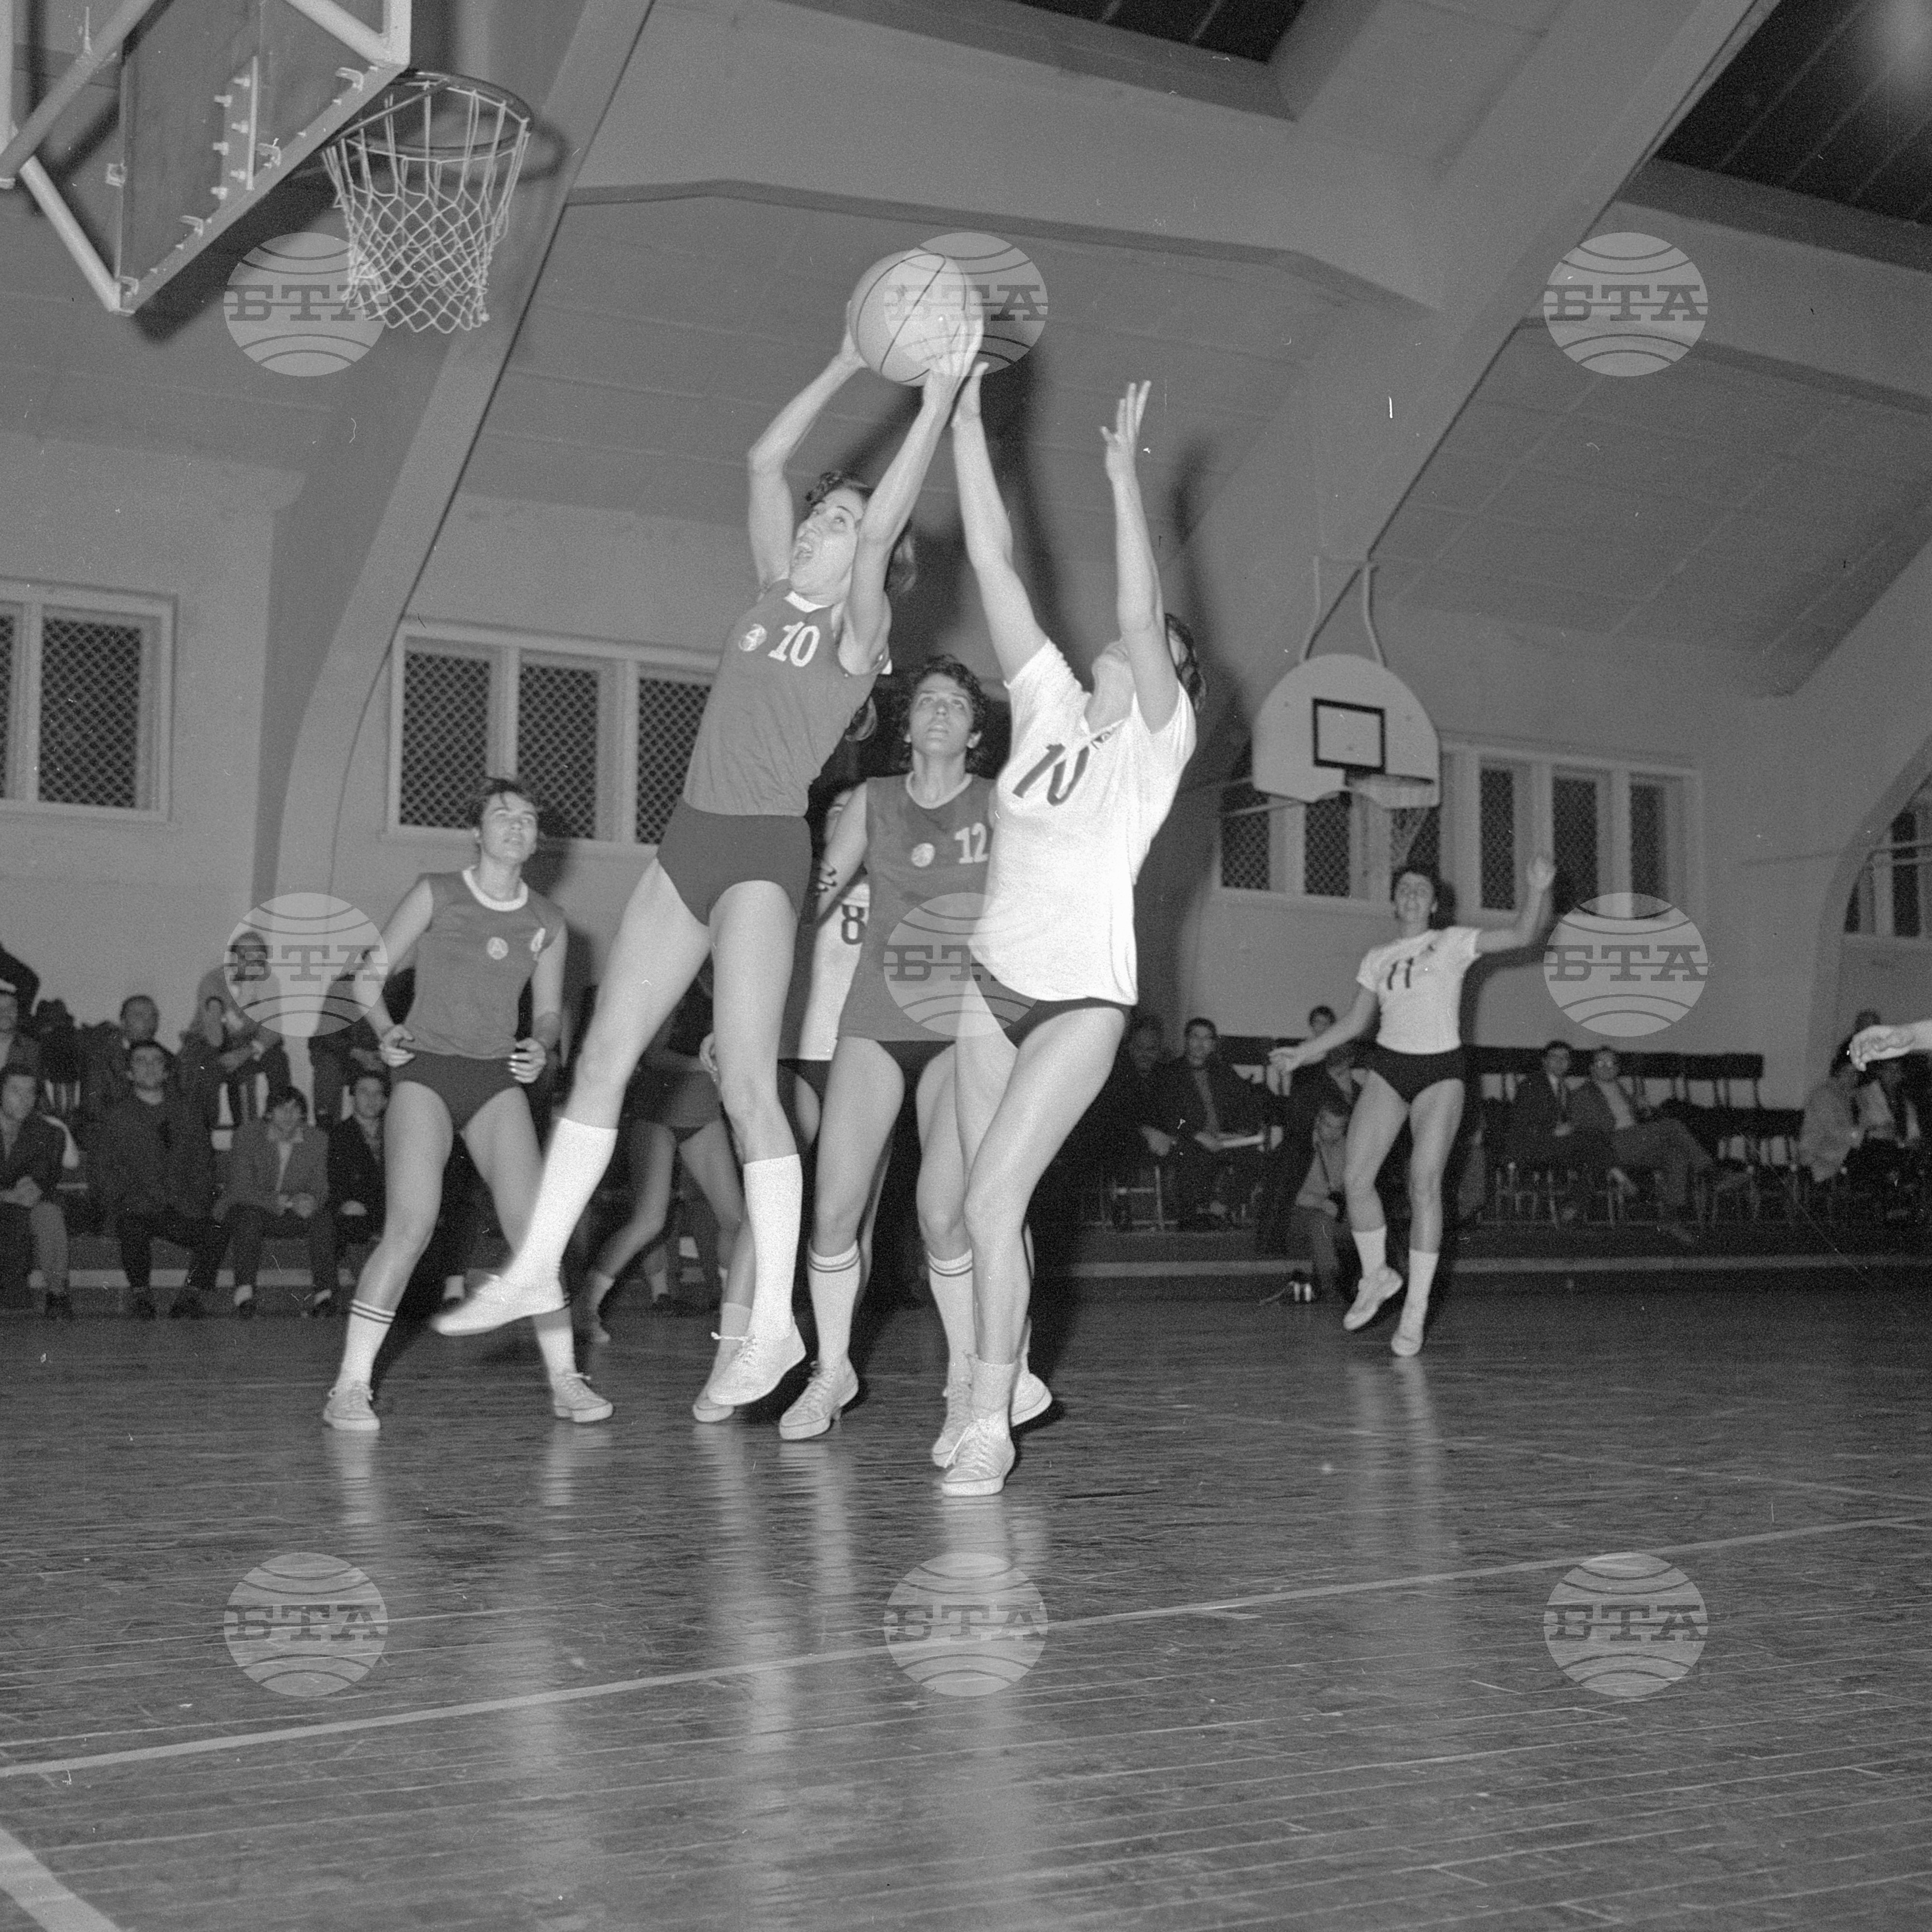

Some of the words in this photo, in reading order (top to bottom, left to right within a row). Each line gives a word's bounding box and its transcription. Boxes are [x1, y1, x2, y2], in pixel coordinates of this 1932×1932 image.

[768, 621, 820, 667] 10
[1012, 743, 1089, 806] 10
[954, 823, 988, 864] 12
[1387, 957, 1414, 990] 11
